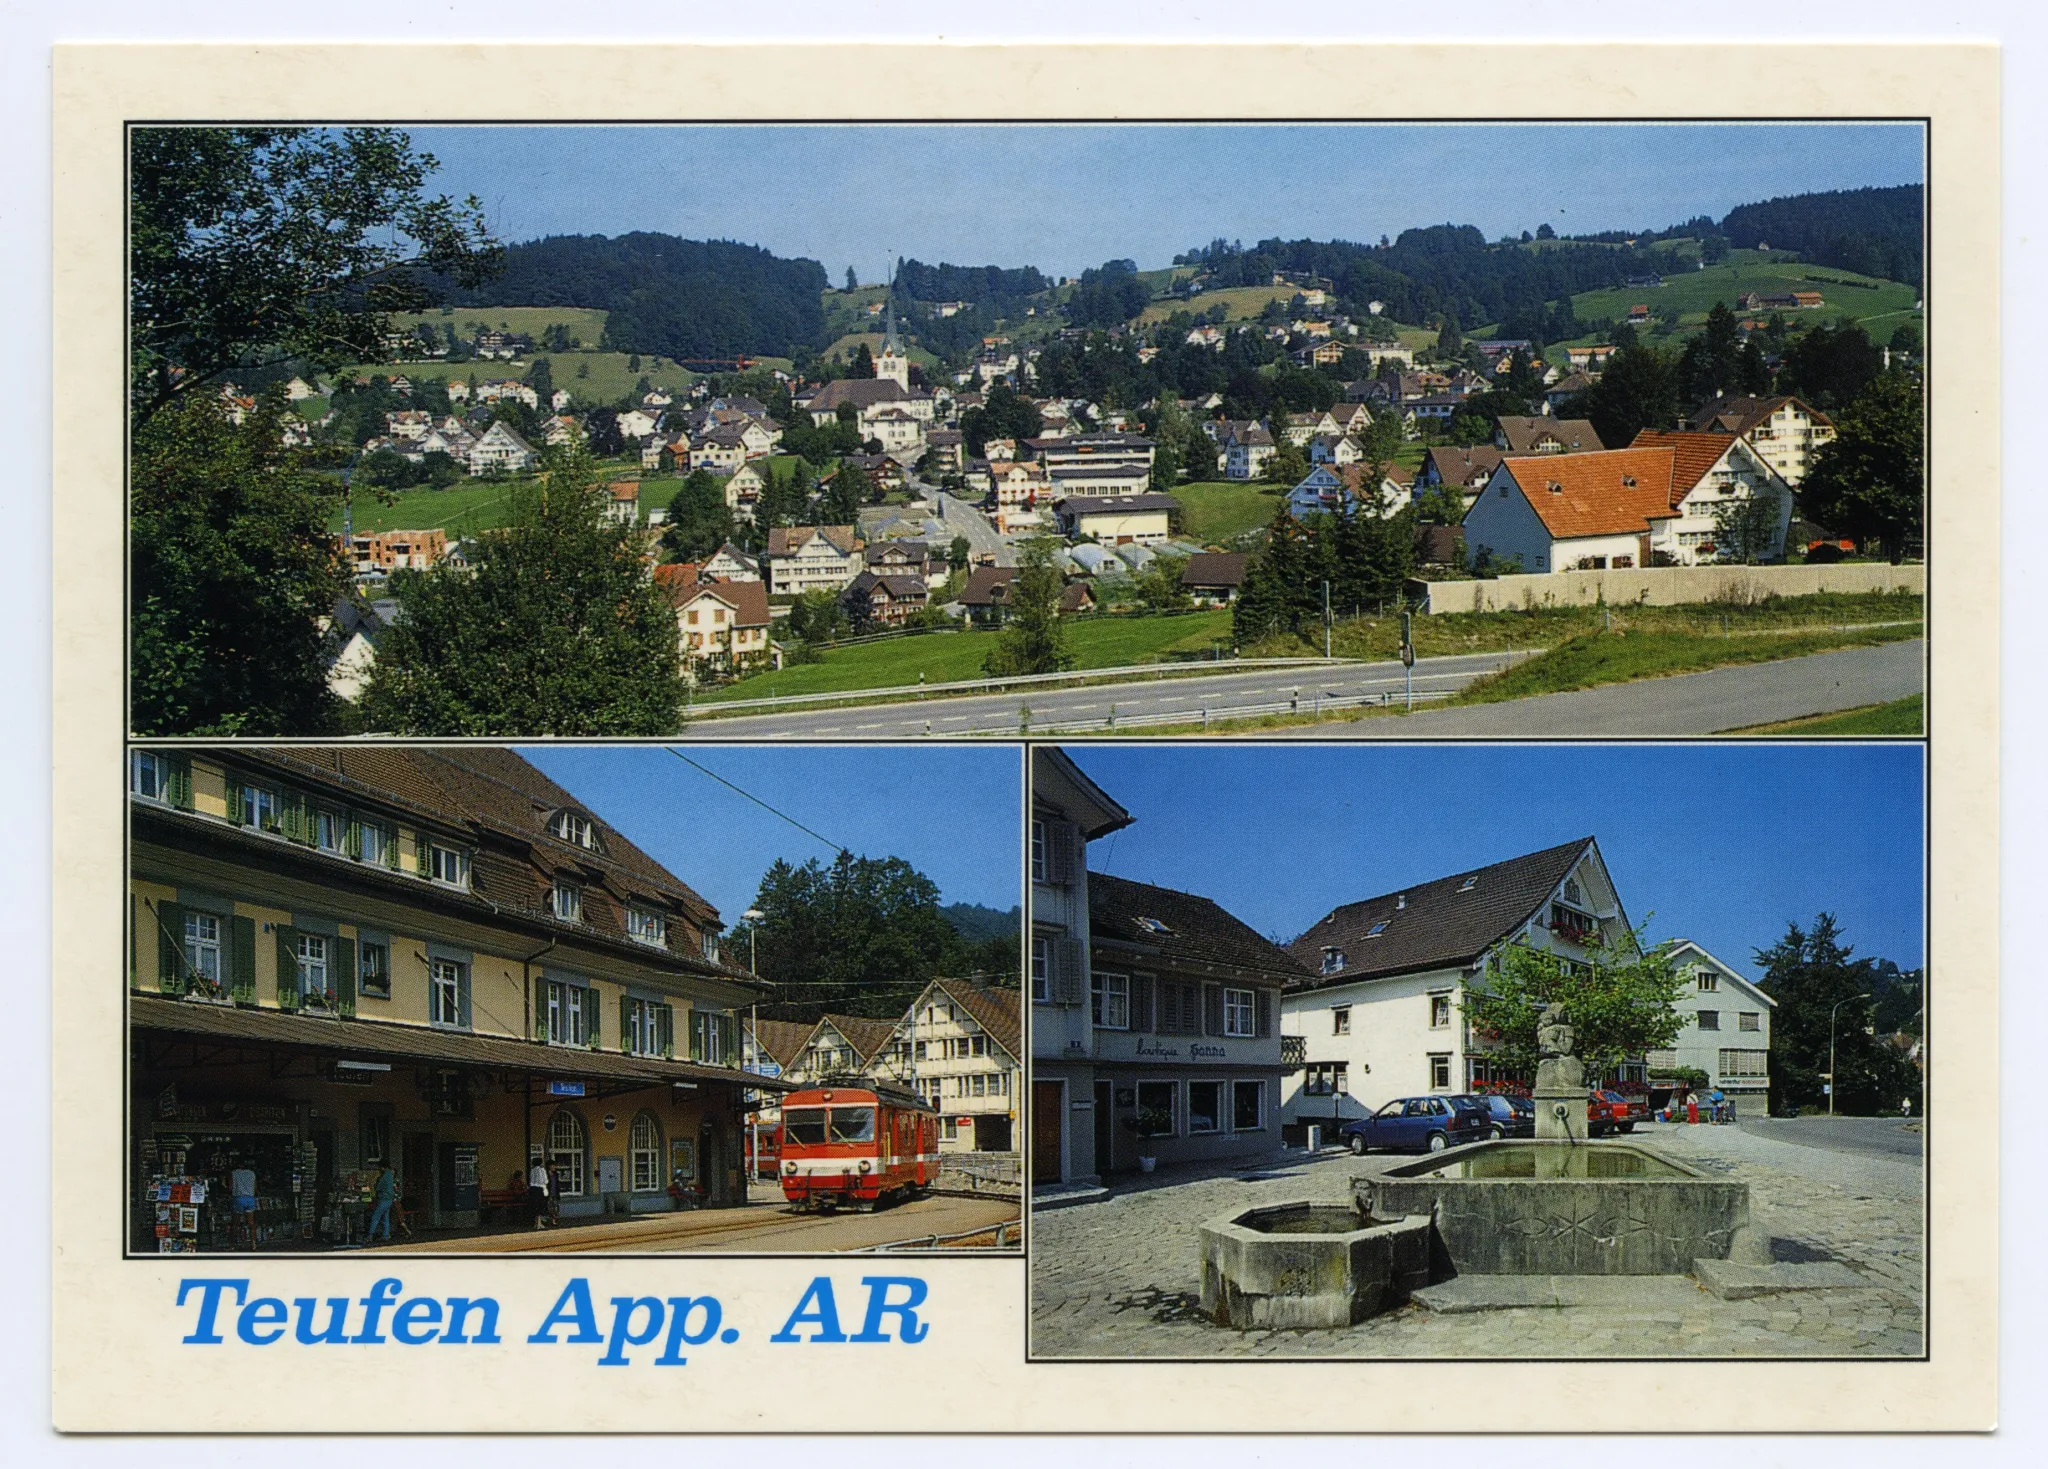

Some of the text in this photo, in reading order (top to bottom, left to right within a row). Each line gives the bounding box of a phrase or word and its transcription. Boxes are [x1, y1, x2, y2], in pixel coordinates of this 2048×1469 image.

[176, 1276, 930, 1366] Teufen App. AR
